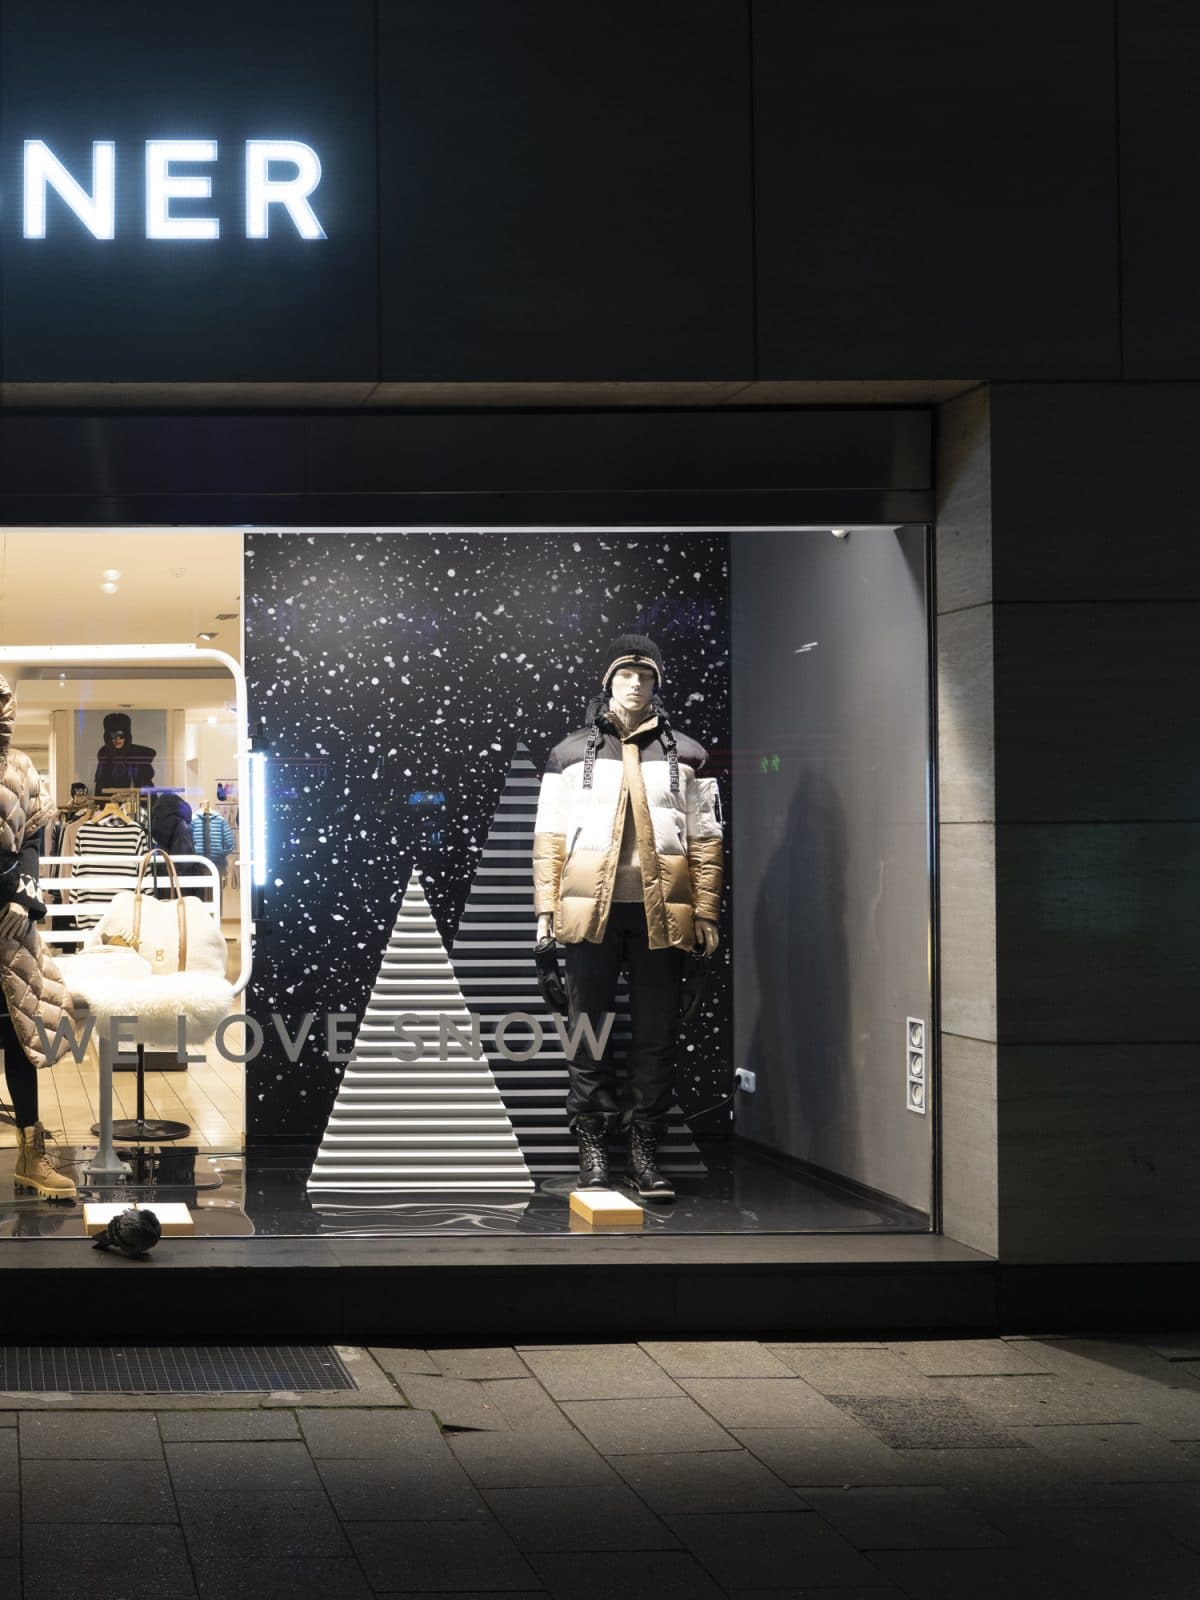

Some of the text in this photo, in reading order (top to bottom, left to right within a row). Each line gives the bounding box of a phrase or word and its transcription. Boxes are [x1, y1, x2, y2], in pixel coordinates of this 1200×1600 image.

[34, 1011, 616, 1064] WE LOVE SNOW
